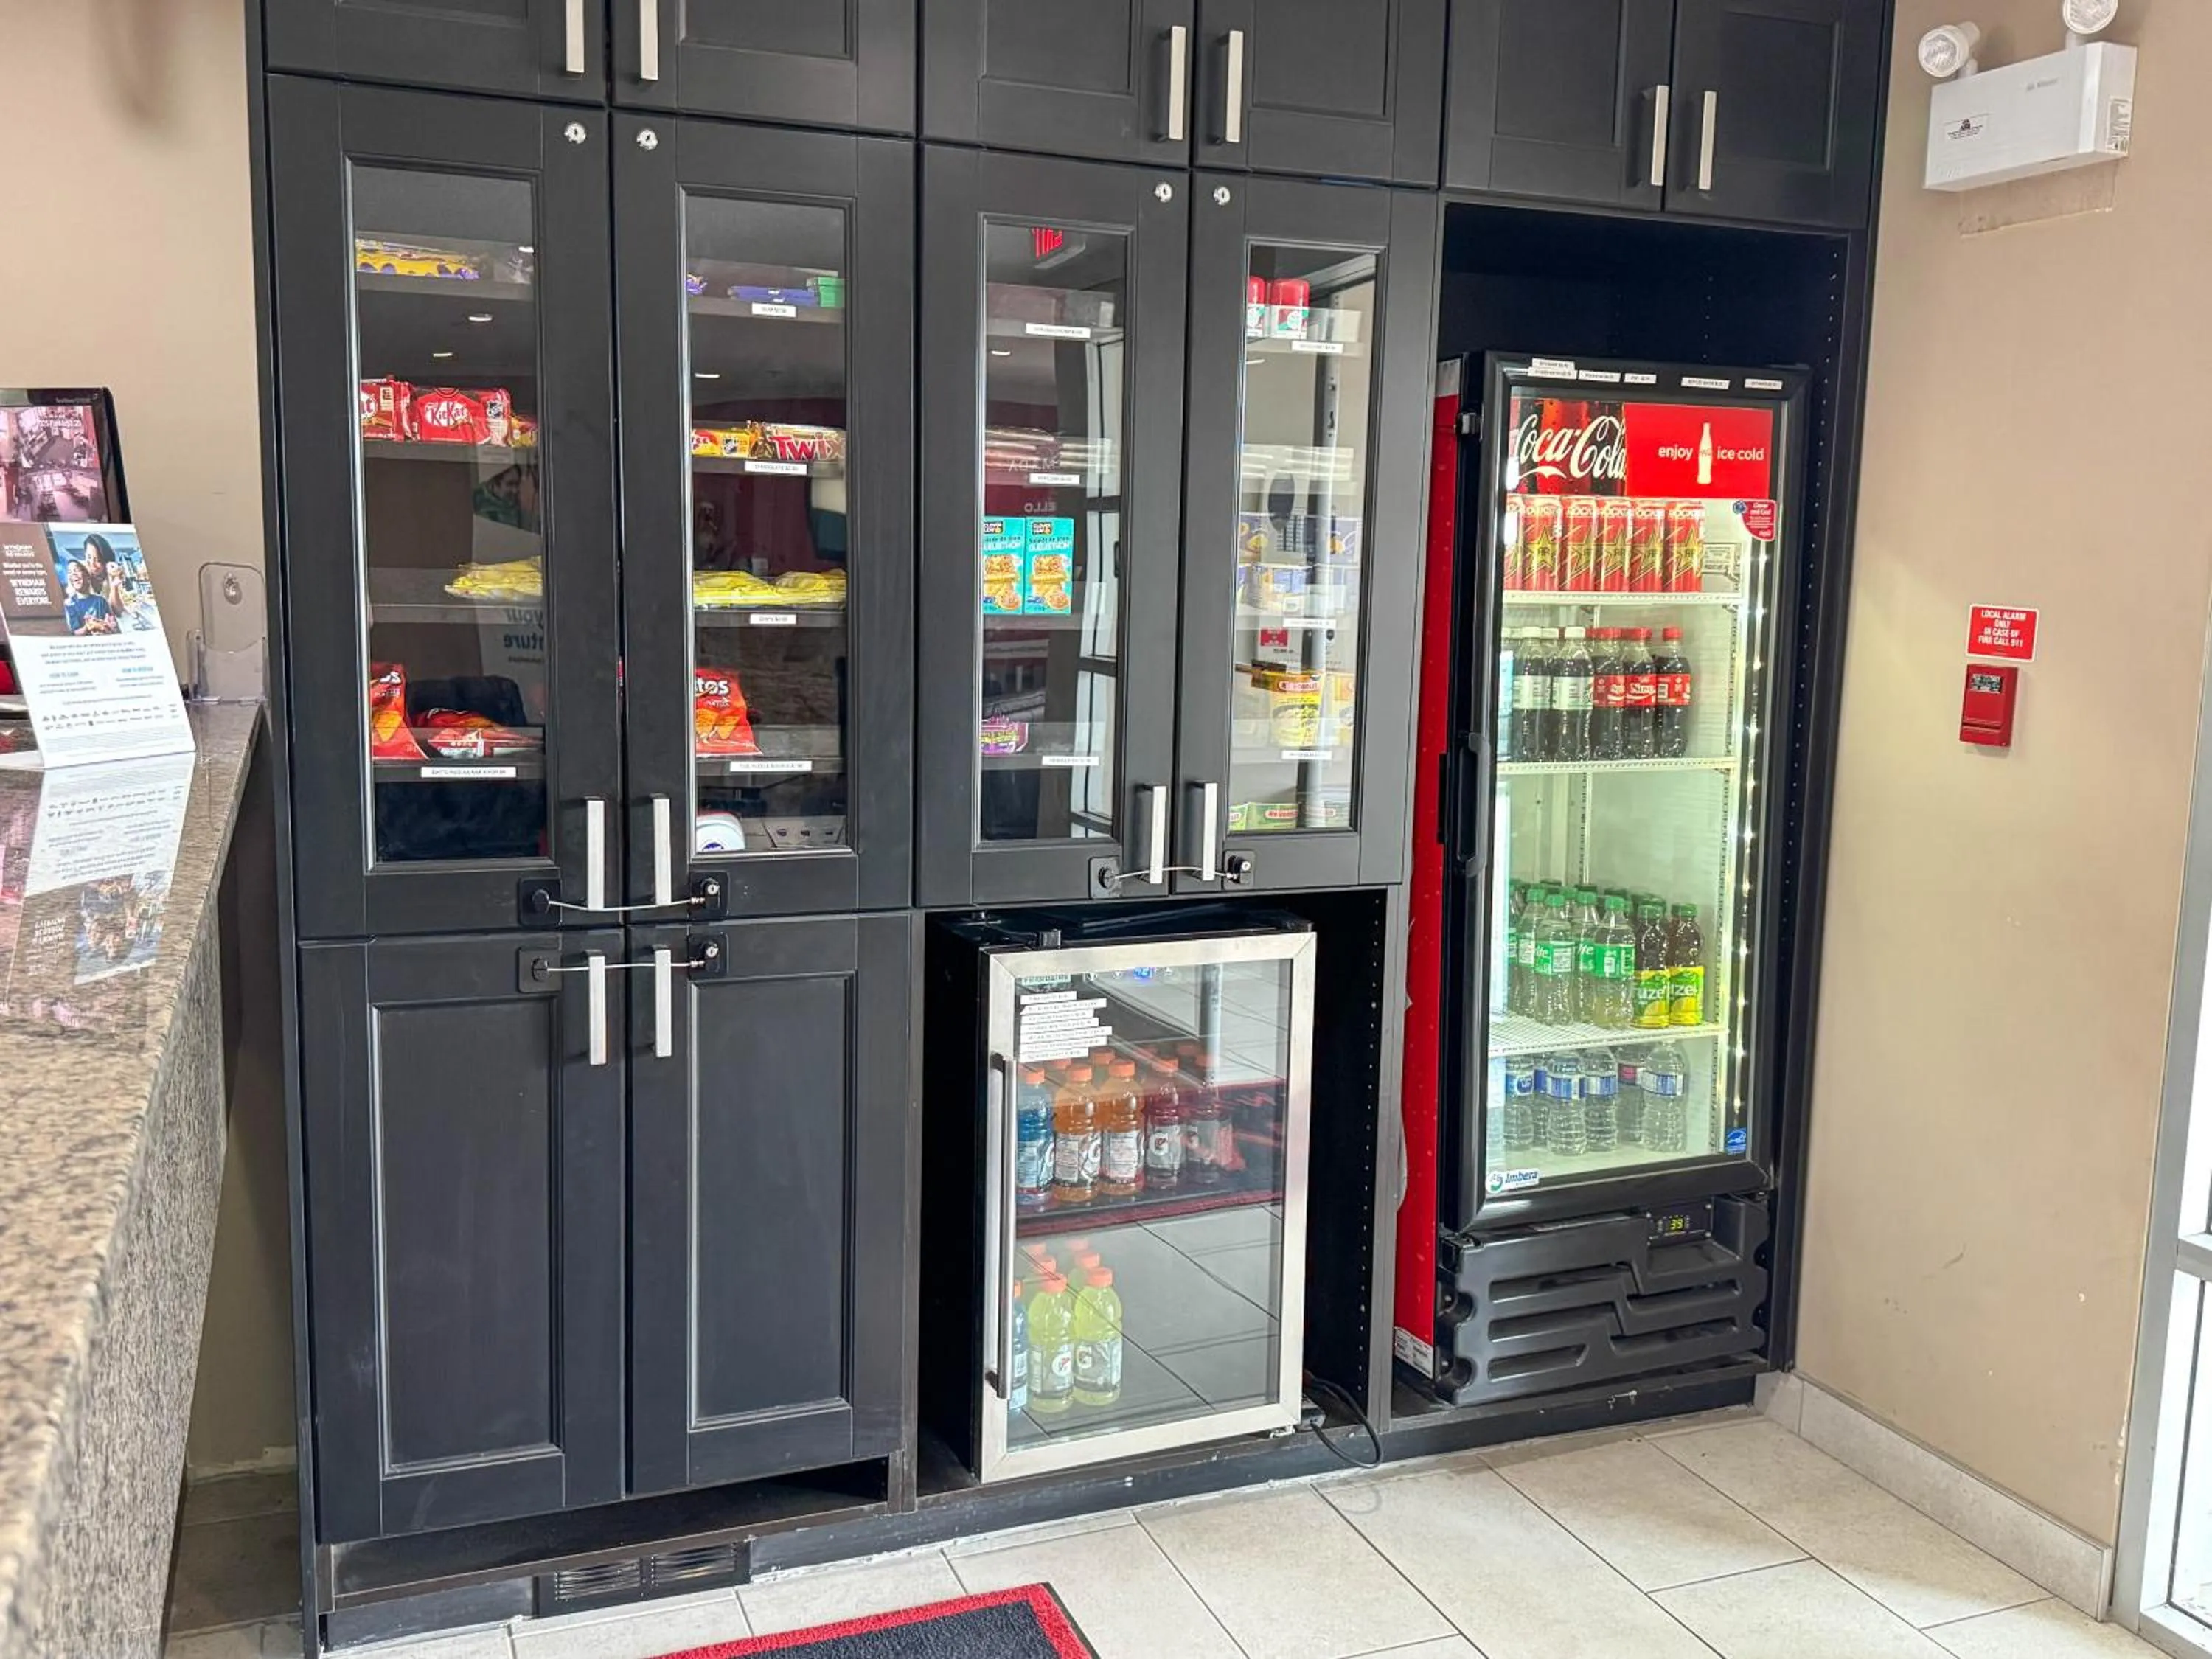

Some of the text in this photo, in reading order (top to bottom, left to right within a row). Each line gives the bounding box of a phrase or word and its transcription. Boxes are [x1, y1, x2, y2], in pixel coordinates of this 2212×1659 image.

[1658, 445, 1764, 461] enjoy ice cold
[1981, 609, 2027, 621] LOCAL ALARM
[1994, 619, 2011, 628] ONLY
[1984, 627, 2020, 638] IN CASE OF
[1978, 635, 2023, 647] FIRE CALL 911
[695, 678, 729, 695] tos
[1638, 987, 1664, 999] uze
[1670, 1219, 1683, 1230] 39
